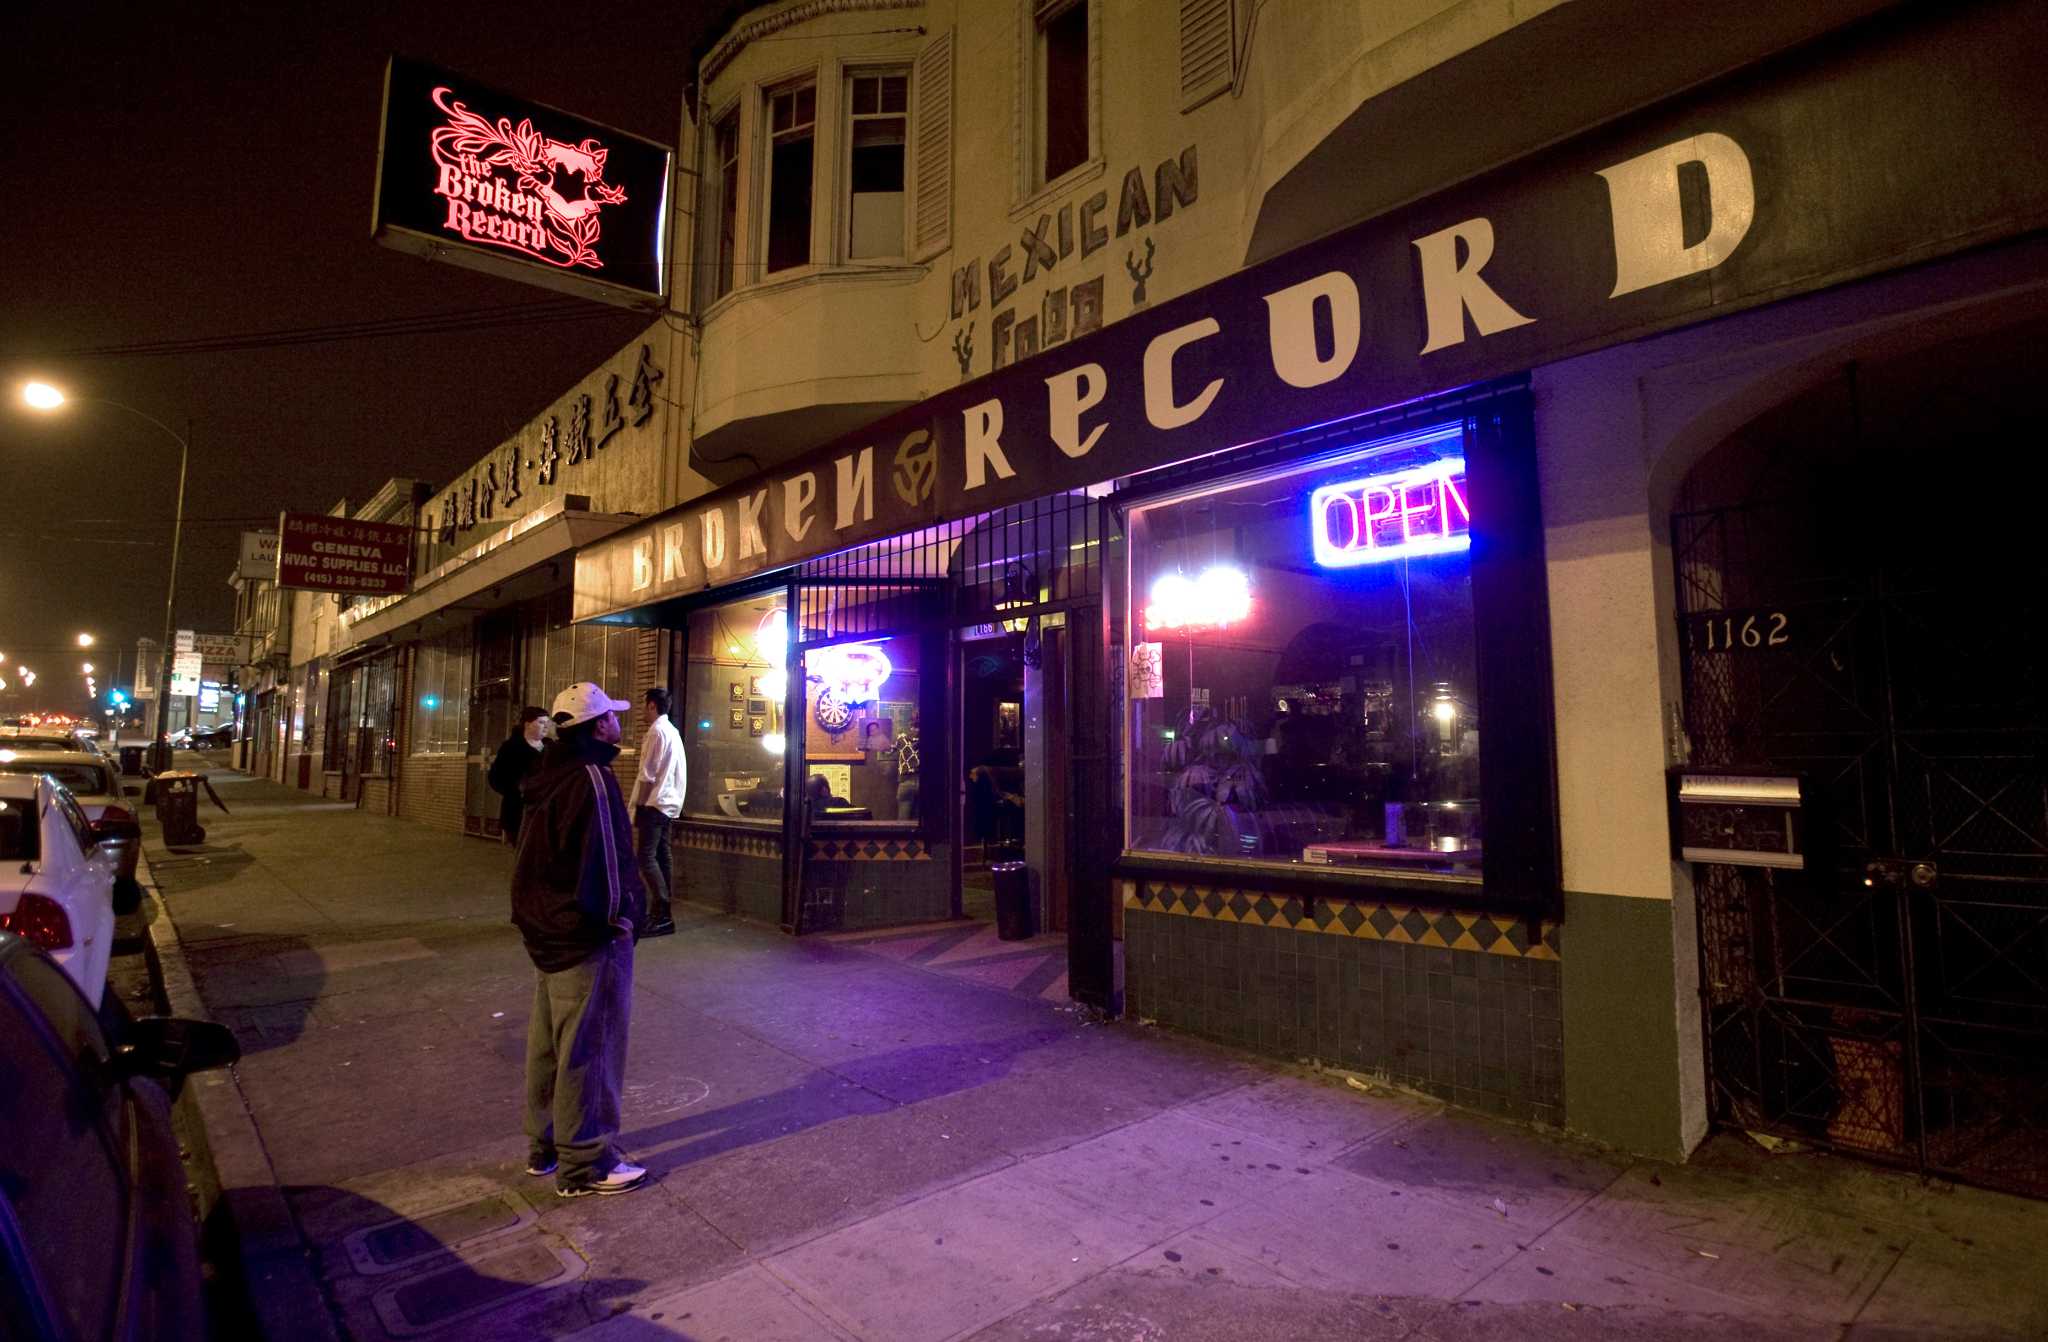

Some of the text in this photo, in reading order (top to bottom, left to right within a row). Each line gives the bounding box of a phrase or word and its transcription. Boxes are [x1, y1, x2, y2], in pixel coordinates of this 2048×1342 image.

[458, 152, 493, 177] the
[433, 162, 545, 221] Broken
[443, 196, 548, 251] Record
[950, 143, 1200, 321] MEXICAN
[284, 553, 317, 568] HVAC
[322, 555, 379, 574] SUPPLIES
[311, 541, 383, 559] GENEVA
[195, 635, 241, 647] APLES
[1706, 612, 1790, 650] 1162
